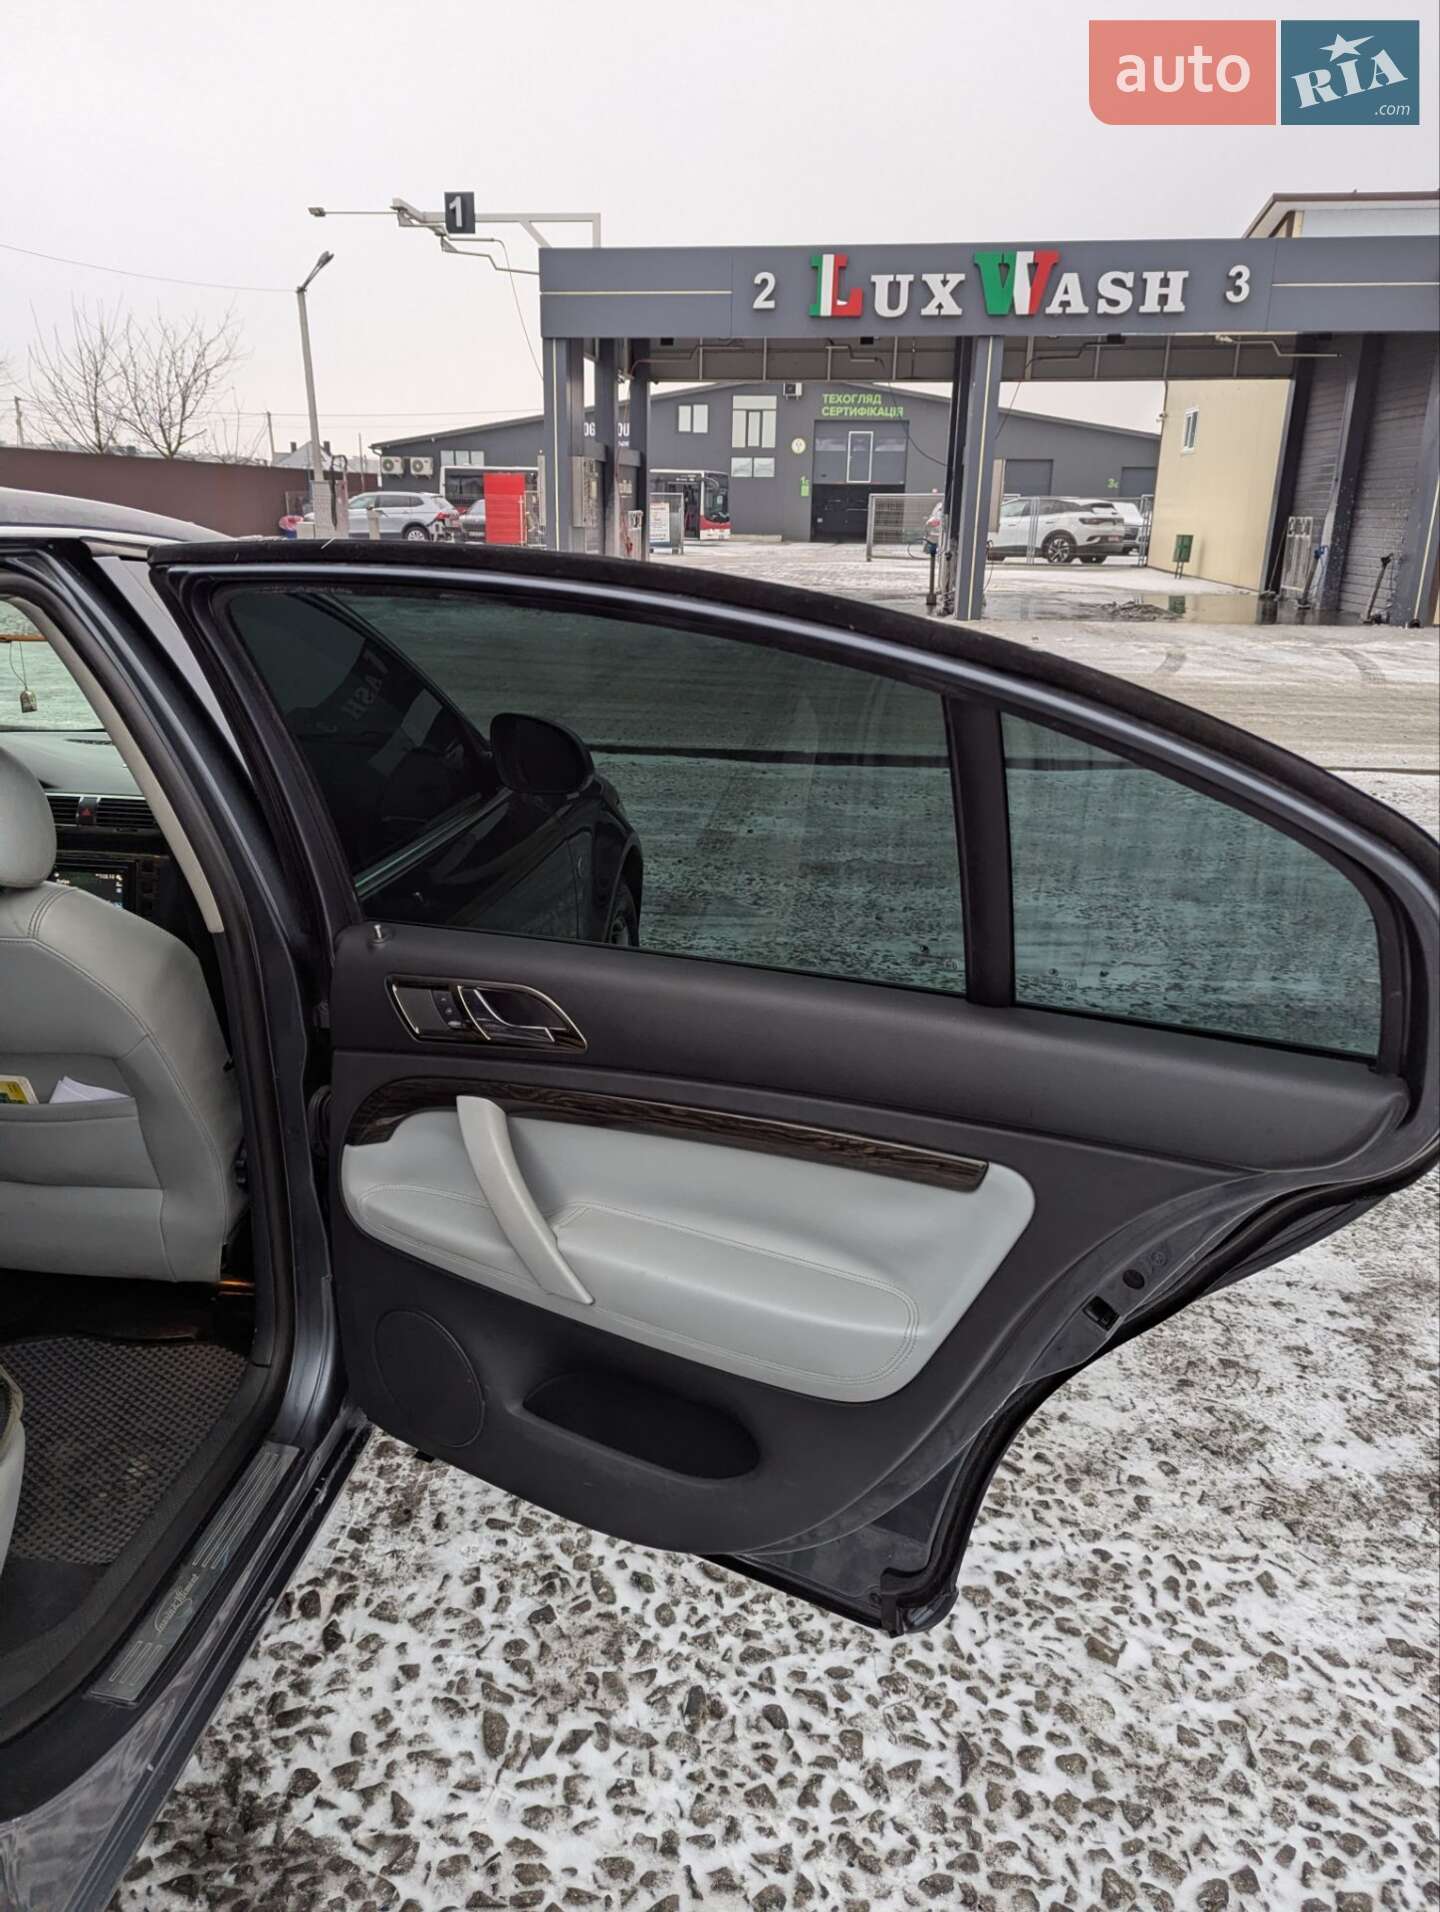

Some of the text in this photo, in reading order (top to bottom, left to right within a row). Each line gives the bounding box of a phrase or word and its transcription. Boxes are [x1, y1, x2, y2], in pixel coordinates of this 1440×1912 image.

[449, 195, 463, 228] 1
[752, 271, 777, 310] 2
[1225, 264, 1251, 304] 3
[822, 393, 882, 405] ТЕХОГЛЯД
[822, 406, 904, 418] СЕРТИФІКАЦІЯ
